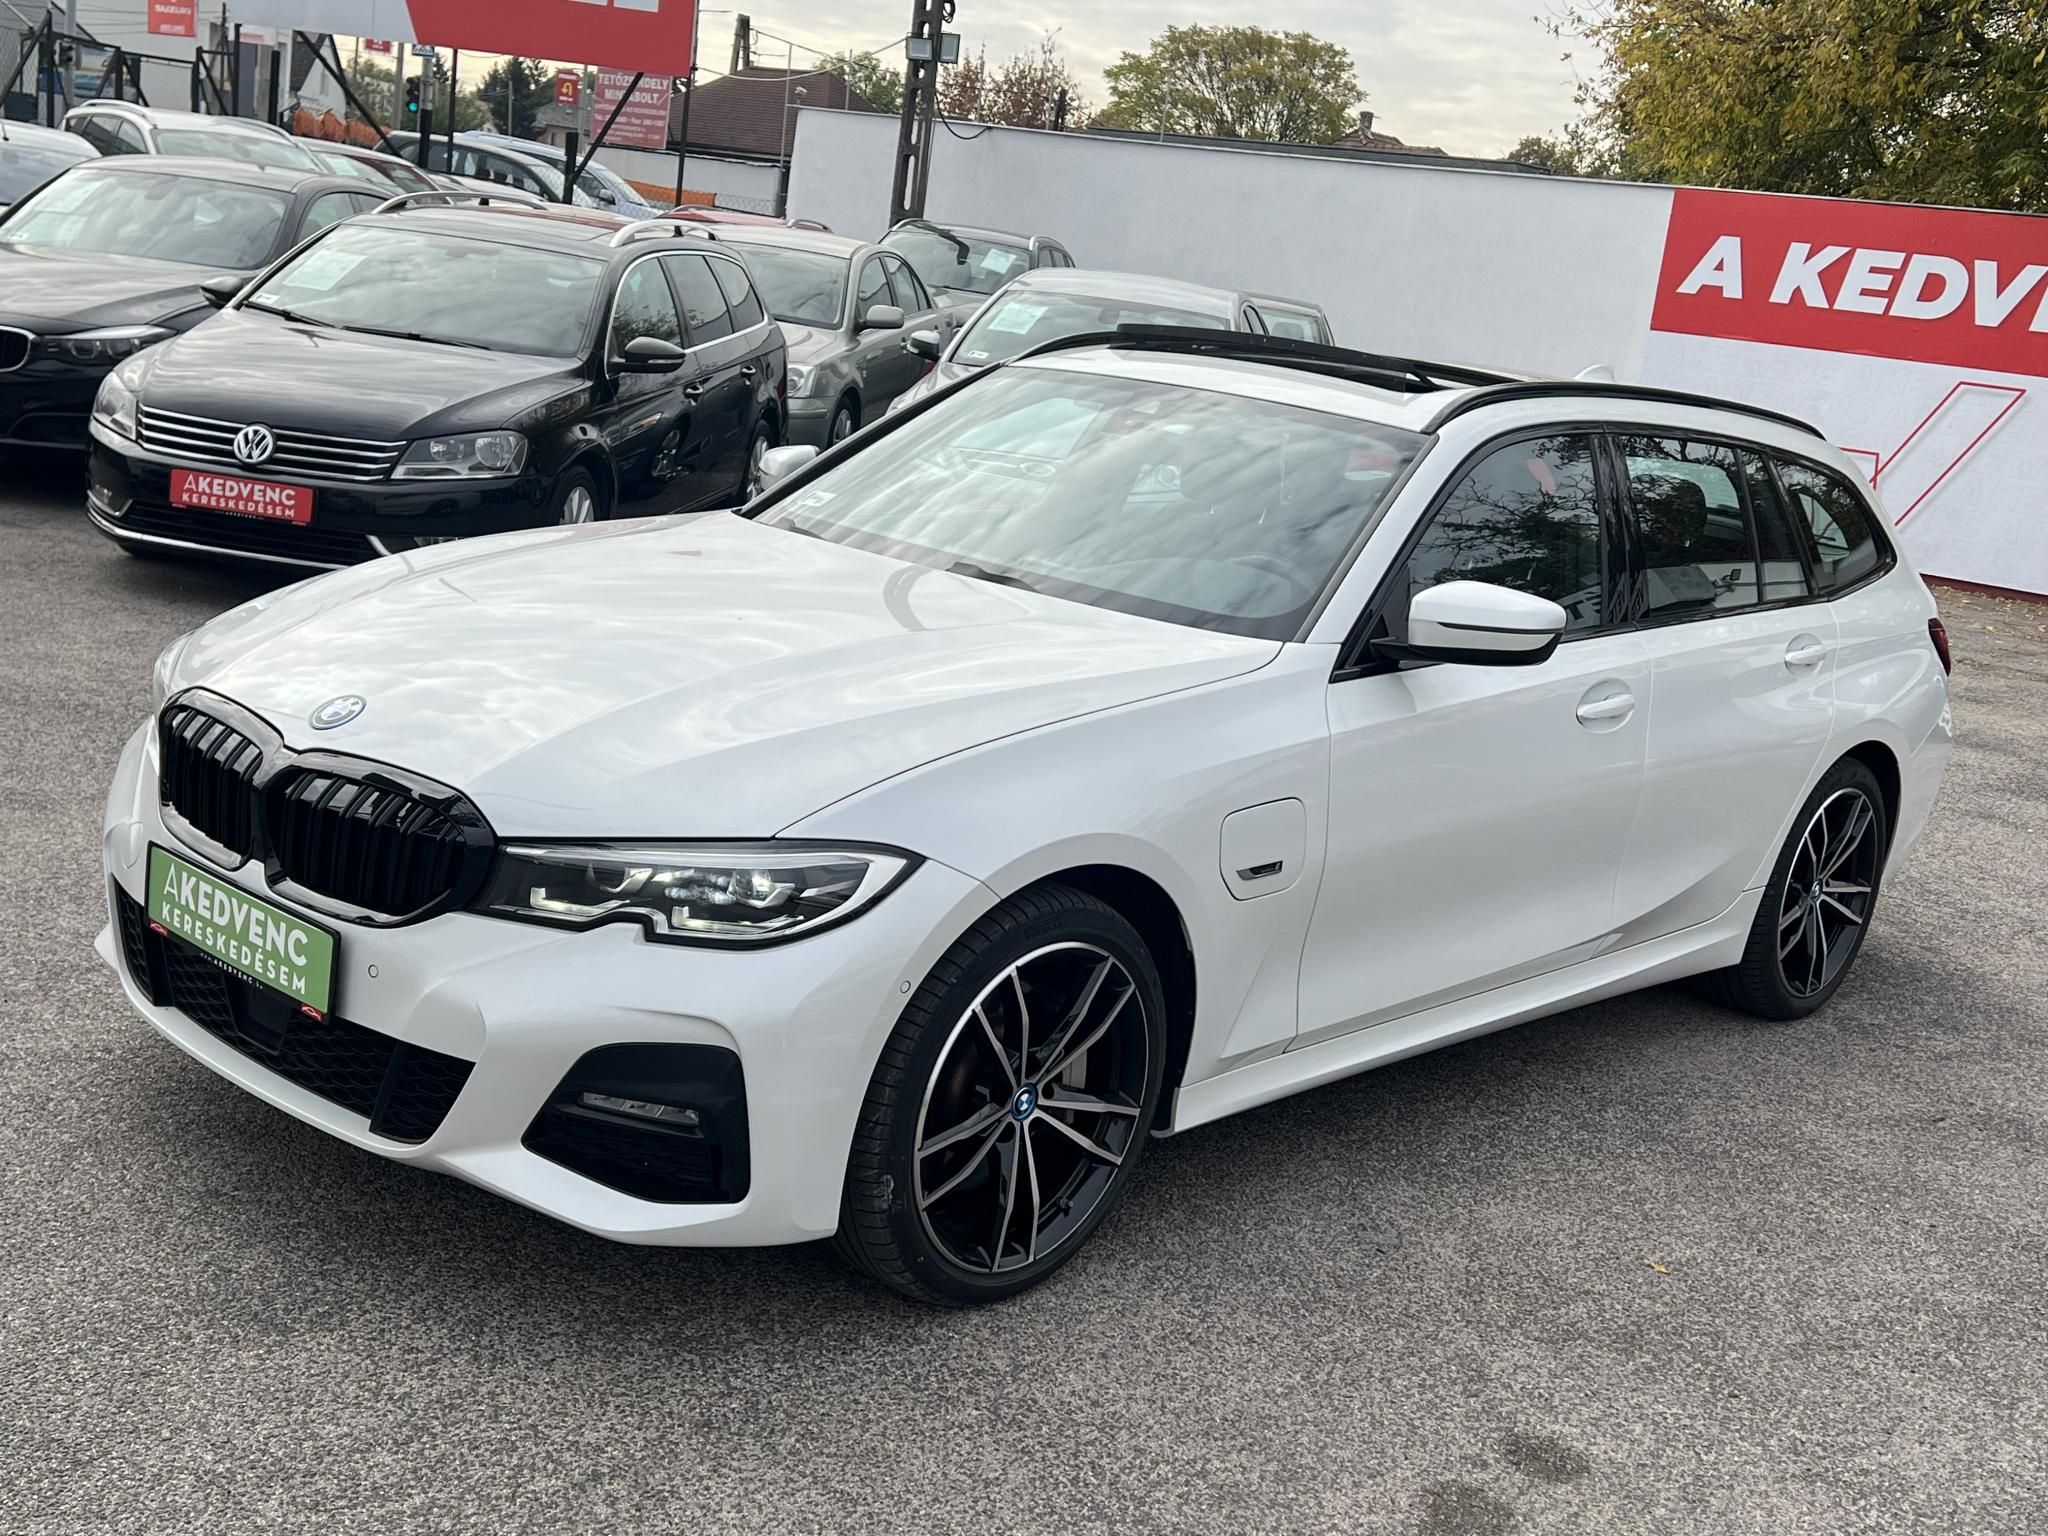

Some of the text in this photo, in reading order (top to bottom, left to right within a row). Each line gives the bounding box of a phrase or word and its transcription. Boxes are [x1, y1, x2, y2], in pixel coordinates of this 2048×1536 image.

[1676, 235, 1743, 299] A
[181, 491, 296, 518] KERESKEDÉSEM
[161, 901, 306, 995] KERESKEDÉSEM
